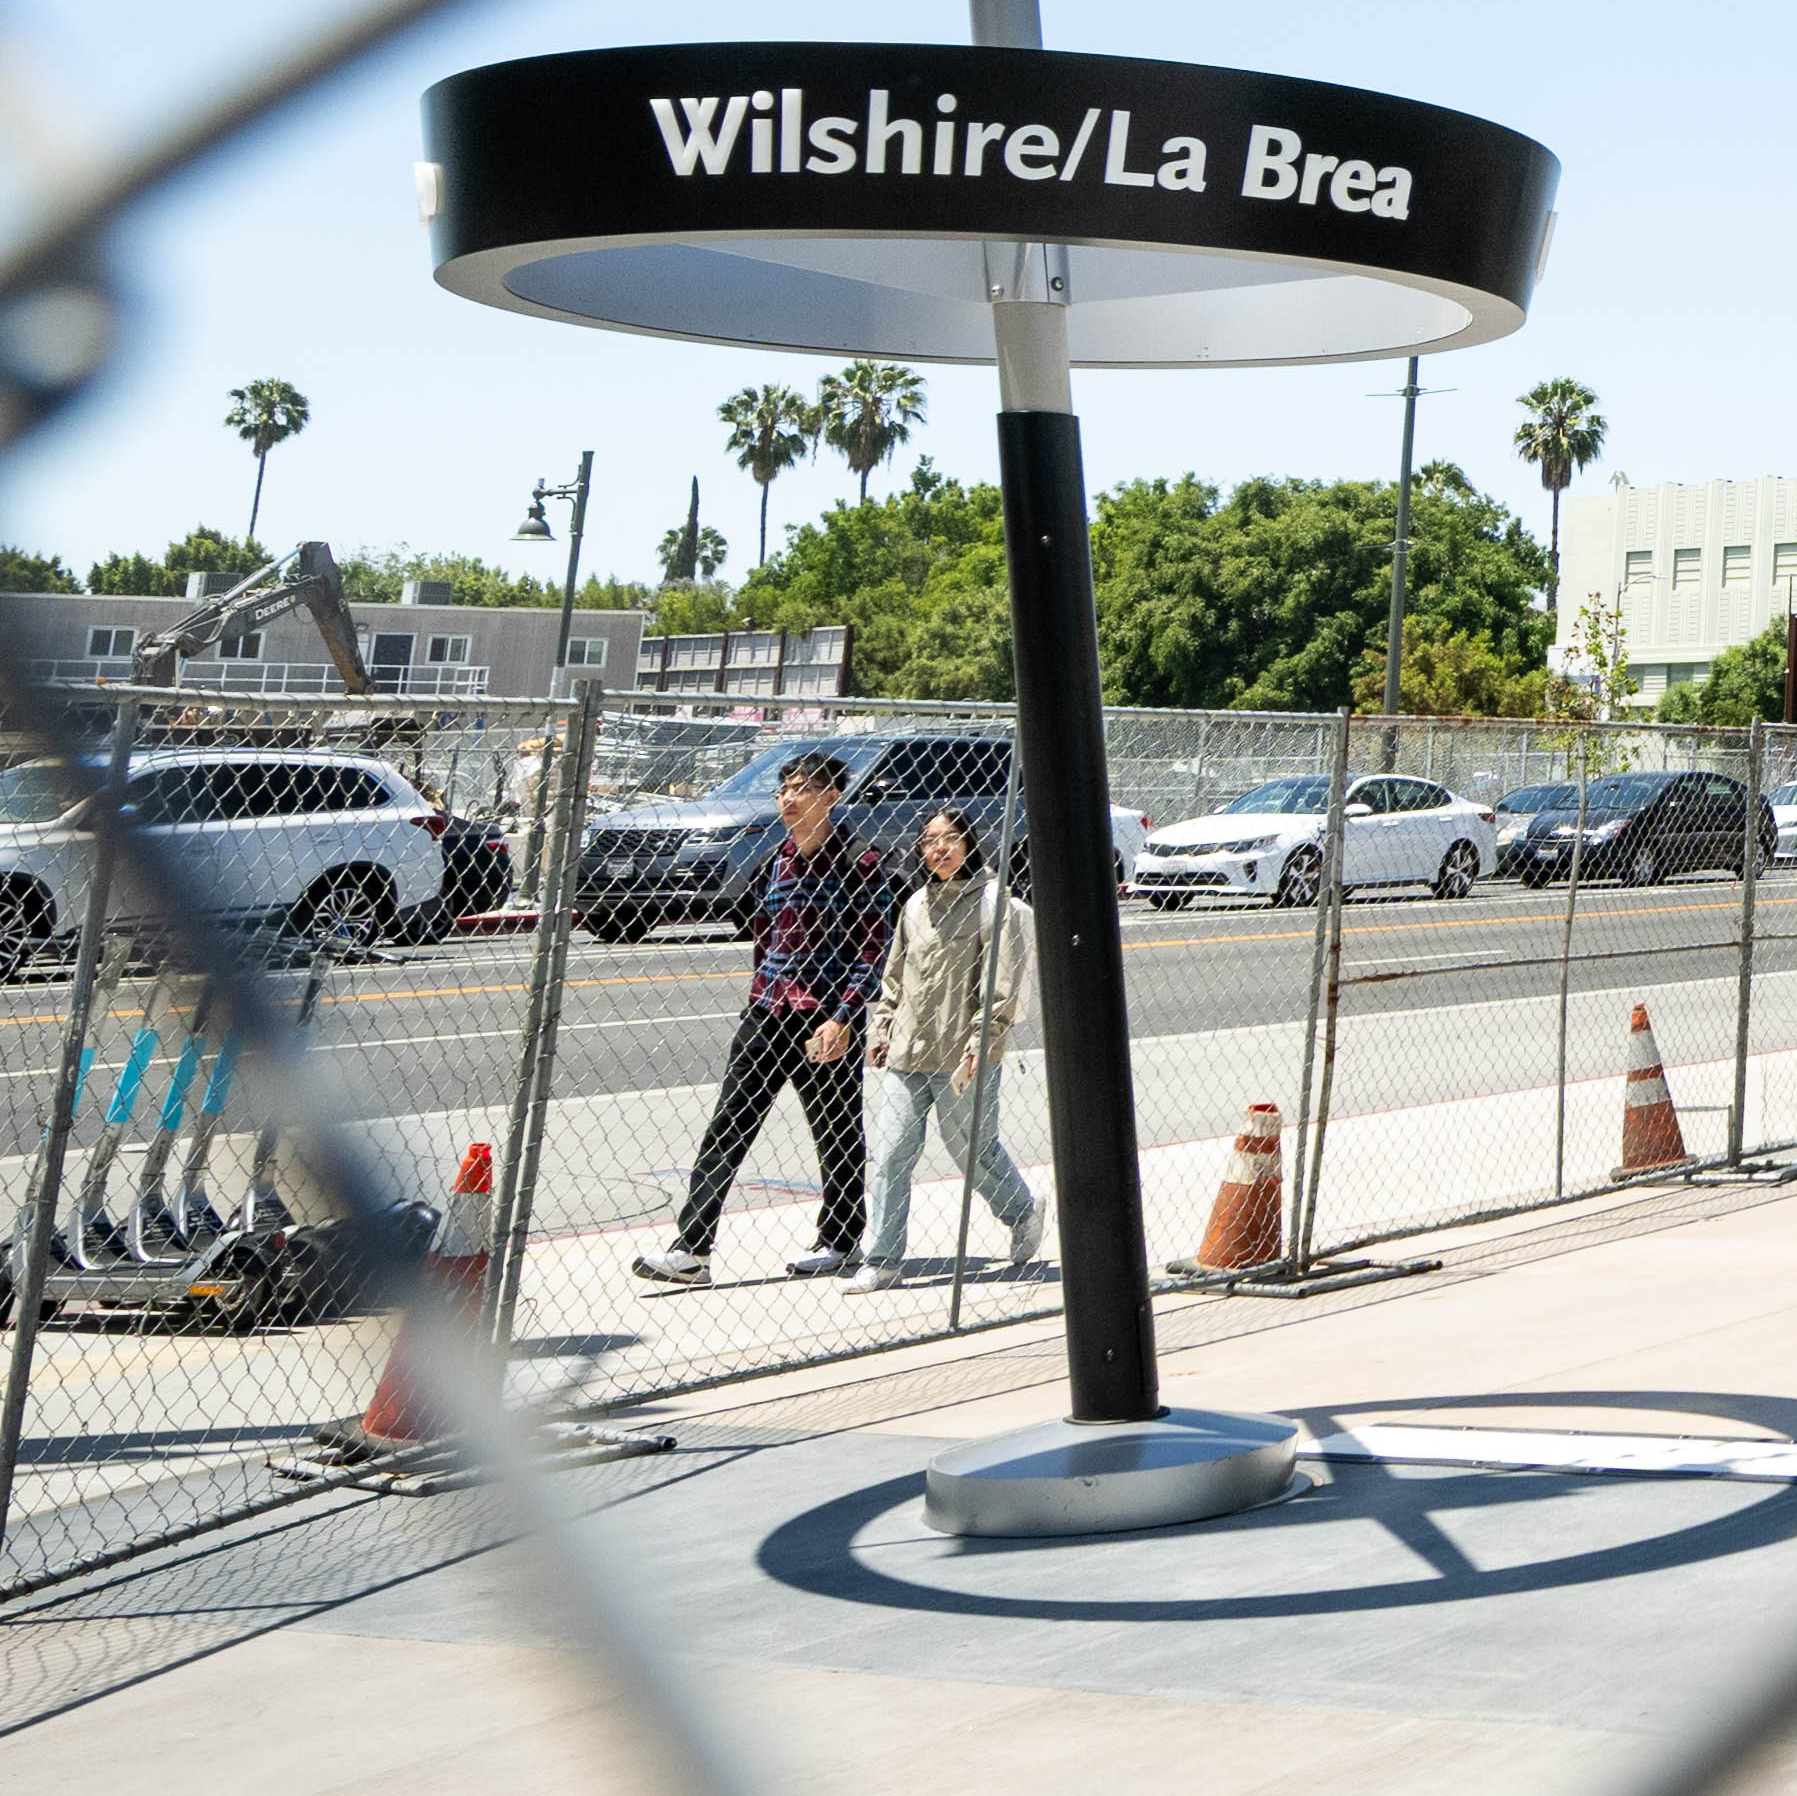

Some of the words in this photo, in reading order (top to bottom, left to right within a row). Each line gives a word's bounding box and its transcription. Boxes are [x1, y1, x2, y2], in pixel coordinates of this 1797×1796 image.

[650, 88, 1207, 193] Wilshire/La
[1240, 124, 1414, 221] Brea
[255, 596, 290, 621] DEERE
